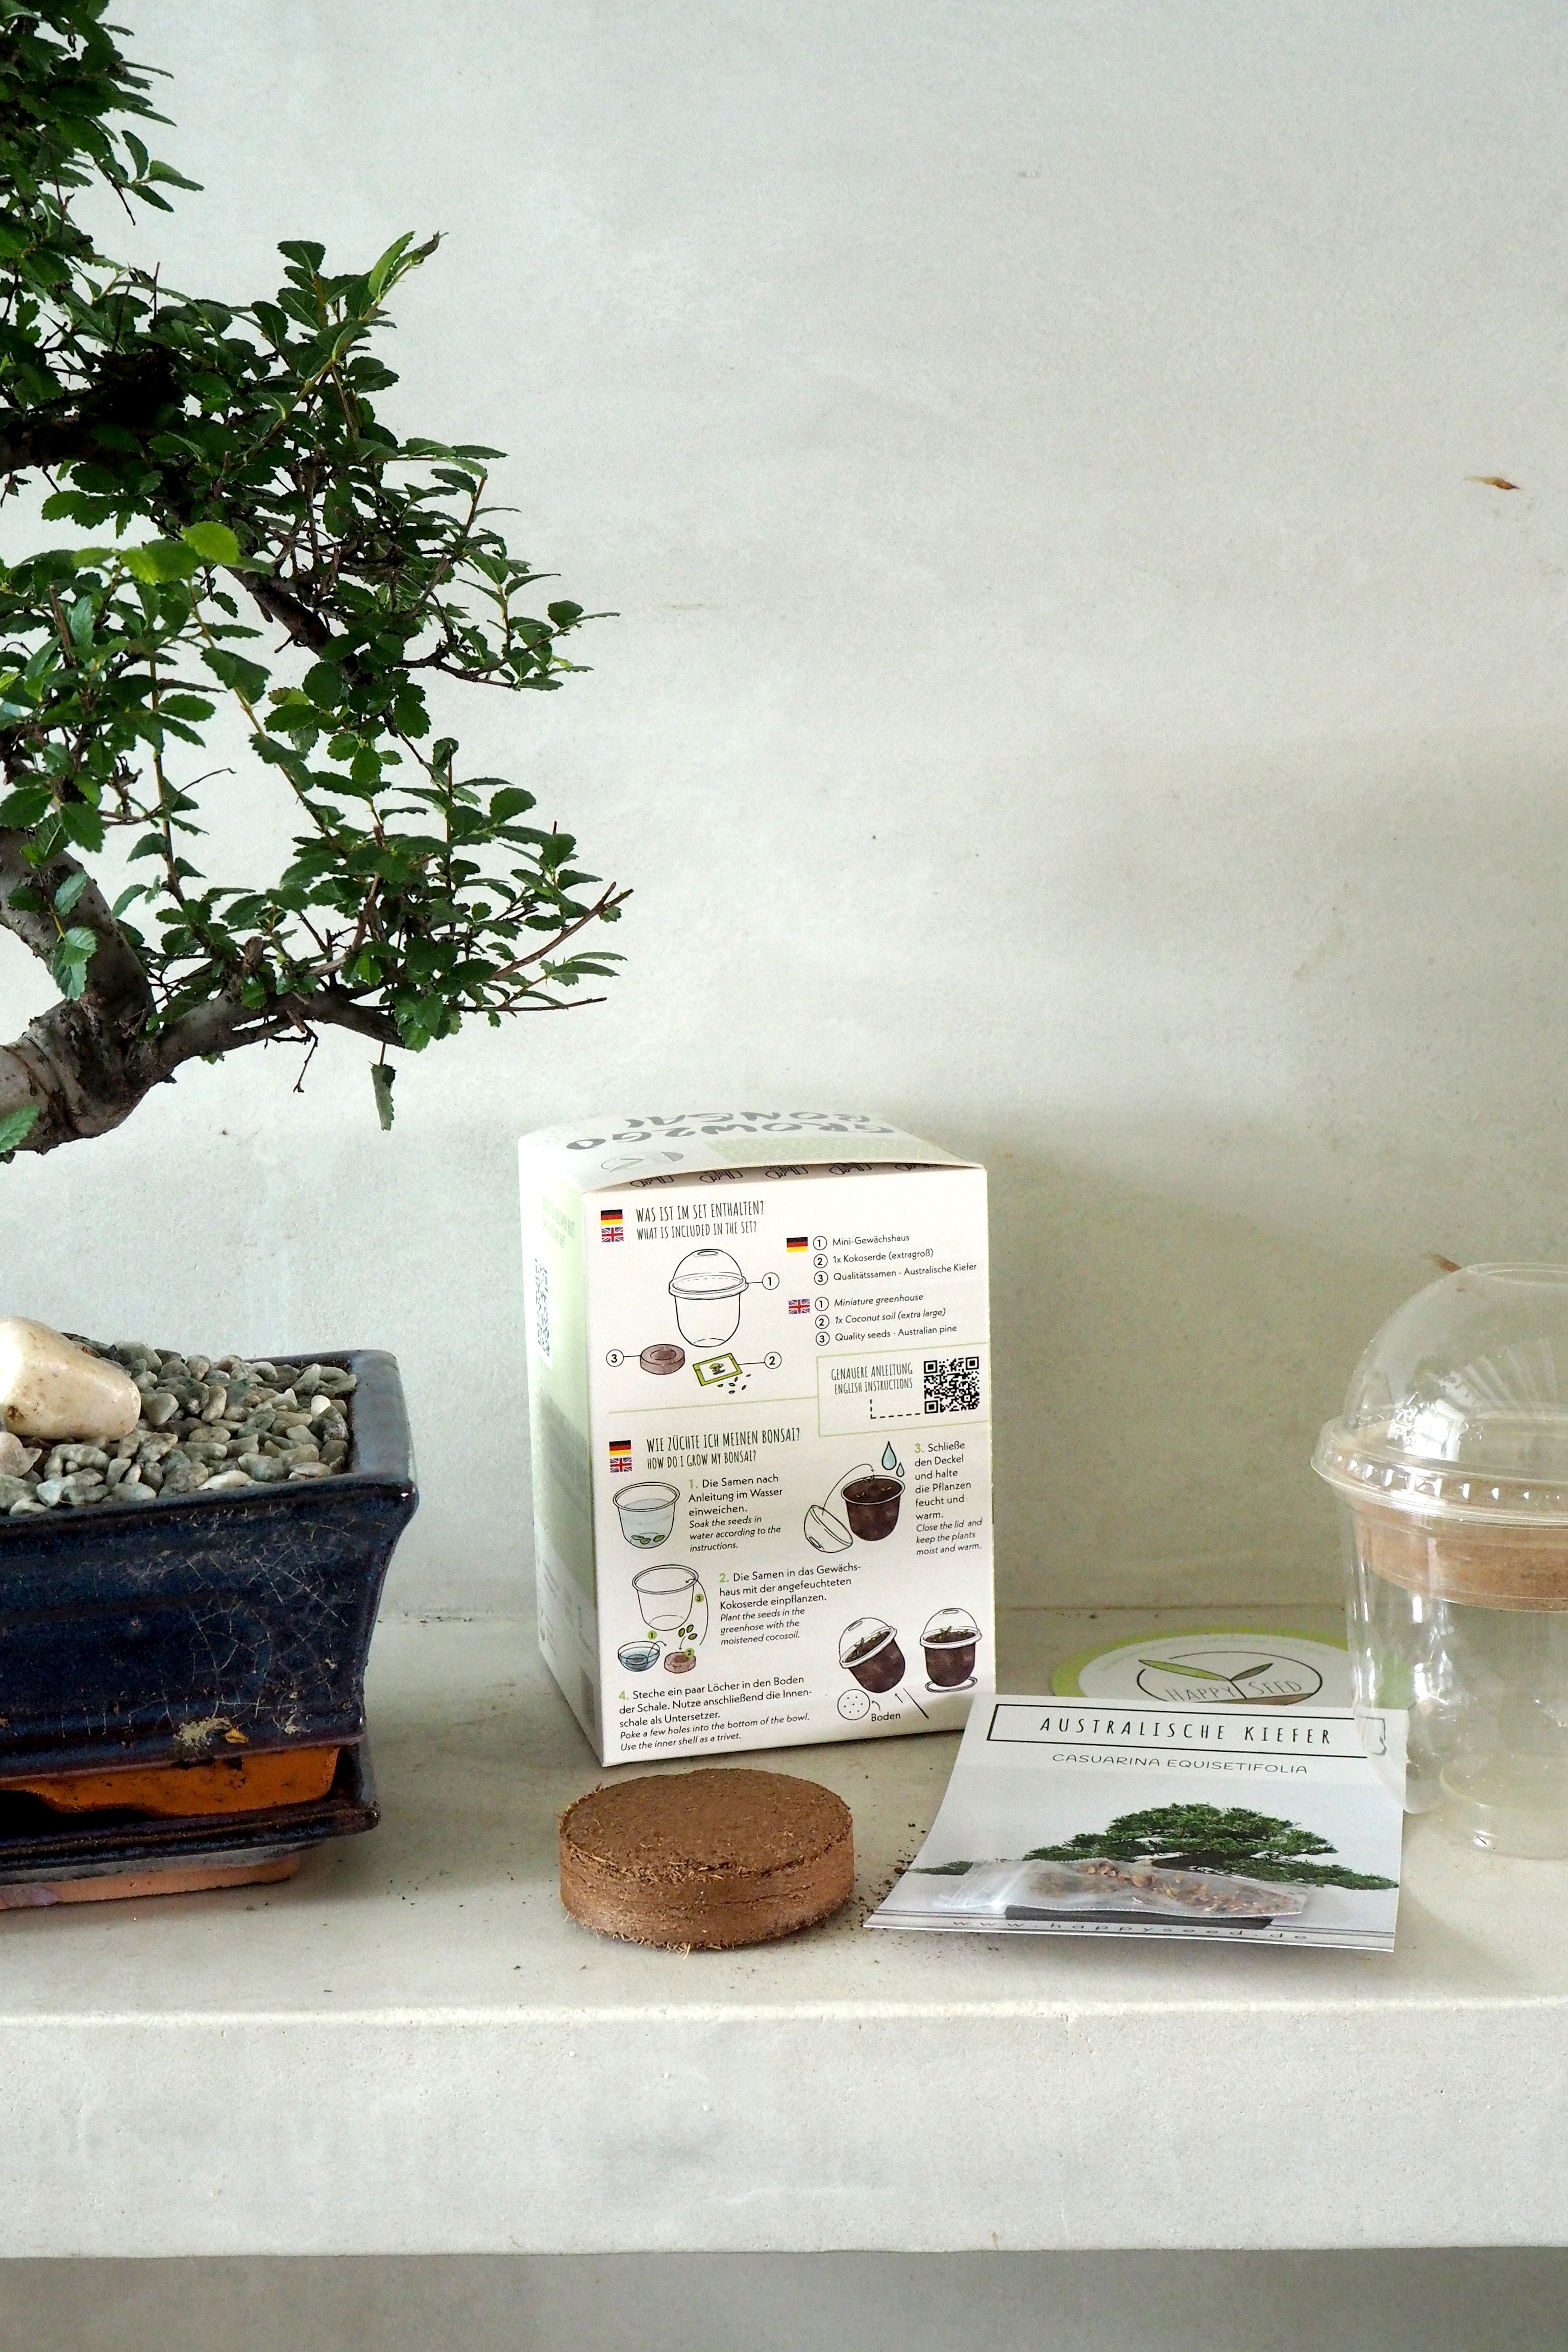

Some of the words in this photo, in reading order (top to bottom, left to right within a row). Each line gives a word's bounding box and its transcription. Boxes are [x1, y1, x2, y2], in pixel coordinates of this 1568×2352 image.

[635, 1207, 656, 1223] WAS
[659, 1206, 674, 1221] IST
[676, 1205, 689, 1220] IM
[693, 1204, 707, 1219] SET
[710, 1200, 764, 1218] ENTHALTEN?
[636, 1227, 657, 1241] WHAT
[660, 1226, 669, 1239] IS
[671, 1223, 710, 1239] INCLUDED
[713, 1222, 723, 1236] IN
[725, 1221, 738, 1235] THE
[741, 1220, 756, 1234] SET?
[832, 1234, 910, 1246] Mini-Gewächshaus
[832, 1255, 842, 1264] 1x
[843, 1252, 887, 1263] Kokoserde
[888, 1247, 934, 1261] (extragroß)
[833, 1270, 897, 1281] Qualitätssamen
[903, 1264, 952, 1276] Australische
[953, 1262, 977, 1272] Kiefer
[834, 1297, 874, 1307] Miniature
[875, 1293, 924, 1306] greenhouse
[835, 1315, 843, 1325] 1x
[845, 1314, 880, 1324] Coconut
[881, 1311, 896, 1321] soil
[897, 1310, 921, 1320] (extra
[922, 1307, 946, 1319] large)
[835, 1331, 866, 1342] Quality
[867, 1329, 891, 1339] seeds
[897, 1326, 938, 1337] Australian
[939, 1325, 958, 1335] pine
[831, 1366, 869, 1381] GENAUERE
[870, 1362, 913, 1378] ANLEITUNG
[835, 1382, 863, 1395] ENGLISH
[864, 1377, 913, 1392] INSTRUCTIONS
[646, 1437, 665, 1453] WIE
[667, 1434, 700, 1452] ZÜCHTE
[703, 1433, 719, 1449] ICH
[722, 1430, 758, 1447] MEINEN
[762, 1427, 800, 1444] BONSAI?
[914, 1443, 925, 1454] 3.
[927, 1440, 965, 1453] Schließe
[647, 1456, 664, 1470] HOW
[667, 1455, 678, 1468] DO
[680, 1455, 684, 1467] I
[687, 1453, 708, 1467] GROW
[711, 1452, 721, 1465] MY
[724, 1450, 756, 1464] BONSAI?
[914, 1457, 933, 1467] den
[934, 1453, 964, 1465] Deckel
[688, 1479, 698, 1489] 1.
[702, 1479, 719, 1488] Die
[721, 1477, 754, 1487] Samen
[756, 1473, 779, 1484] nach
[915, 1469, 933, 1481] und
[935, 1467, 959, 1479] halte
[688, 1492, 734, 1503] Anleitung
[736, 1490, 748, 1500] im
[749, 1488, 783, 1499] Wasser
[915, 1484, 930, 1494] die
[933, 1482, 972, 1492] Pflanzen
[915, 1496, 945, 1508] feucht
[946, 1493, 965, 1504] und
[689, 1504, 747, 1517] einweichen.
[915, 1512, 944, 1521] warm.
[689, 1518, 710, 1529] Soak
[712, 1517, 726, 1527] the
[727, 1515, 753, 1526] seeds
[754, 1515, 762, 1524] in
[916, 1523, 938, 1532] Close
[940, 1521, 953, 1530] the
[954, 1519, 965, 1528] lid
[967, 1517, 983, 1527] and
[715, 1528, 756, 1538] according
[768, 1525, 781, 1534] the
[916, 1535, 936, 1545] keep
[937, 1533, 950, 1542] the
[951, 1531, 976, 1543] plants
[690, 1541, 739, 1552] instructions.
[916, 1547, 939, 1556] moist
[940, 1544, 956, 1553] and
[719, 1573, 729, 1583] 2.
[733, 1573, 750, 1582] Die
[752, 1571, 785, 1581] Samen
[787, 1569, 795, 1578] in
[797, 1566, 814, 1576] das
[816, 1562, 862, 1575] Gewächs-
[719, 1587, 741, 1597] haus
[743, 1584, 757, 1595] mit
[760, 1583, 776, 1593] der
[777, 1578, 852, 1593] angefeuchteten
[720, 1597, 769, 1610] Kokoserde
[770, 1594, 827, 1607] einpflanzen.
[720, 1613, 741, 1622] Plant
[742, 1611, 756, 1620] the
[757, 1608, 781, 1619] seeds
[782, 1608, 790, 1616] in
[792, 1606, 805, 1615] the
[720, 1623, 764, 1636] greenhose
[766, 1620, 784, 1629] with
[786, 1619, 800, 1628] the
[721, 1633, 765, 1646] moistened
[765, 1630, 800, 1641] cocosoil.
[618, 1690, 629, 1701] 4.
[632, 1688, 666, 1700] Steche
[667, 1686, 682, 1696] ein
[684, 1686, 706, 1697] paar
[707, 1681, 740, 1693] Löcher
[742, 1680, 750, 1689] in
[752, 1678, 771, 1688] den
[773, 1675, 804, 1686] Boden
[1166, 1686, 1235, 1701] HAPPY
[619, 1705, 636, 1714] der
[637, 1701, 670, 1713] Schale.
[672, 1699, 701, 1709] Nutze
[703, 1691, 764, 1706] anschließend
[766, 1690, 780, 1700] die
[782, 1689, 813, 1699] Innen-
[619, 1717, 648, 1728] schale
[650, 1714, 663, 1725] als
[664, 1712, 720, 1724] Untersetzer.
[871, 1711, 901, 1722] Boden
[620, 1730, 641, 1740] Poke
[650, 1728, 667, 1737] few
[668, 1725, 691, 1735] holes
[692, 1724, 709, 1732] into
[711, 1722, 725, 1730] the
[727, 1720, 758, 1729] bottom
[760, 1716, 770, 1725] of
[770, 1716, 785, 1724] the
[786, 1711, 810, 1723] bowl.
[1040, 1718, 1224, 1739] AUSTRALISCHE
[1245, 1726, 1329, 1744] KIEFER
[621, 1742, 637, 1751] Use
[639, 1741, 653, 1750] the
[654, 1739, 677, 1748] inner
[678, 1735, 698, 1745] shell
[717, 1732, 741, 1742] trivet.
[1052, 1754, 1160, 1766] CASUARINA
[1167, 1759, 1307, 1774] EQUISETIFOLIA
